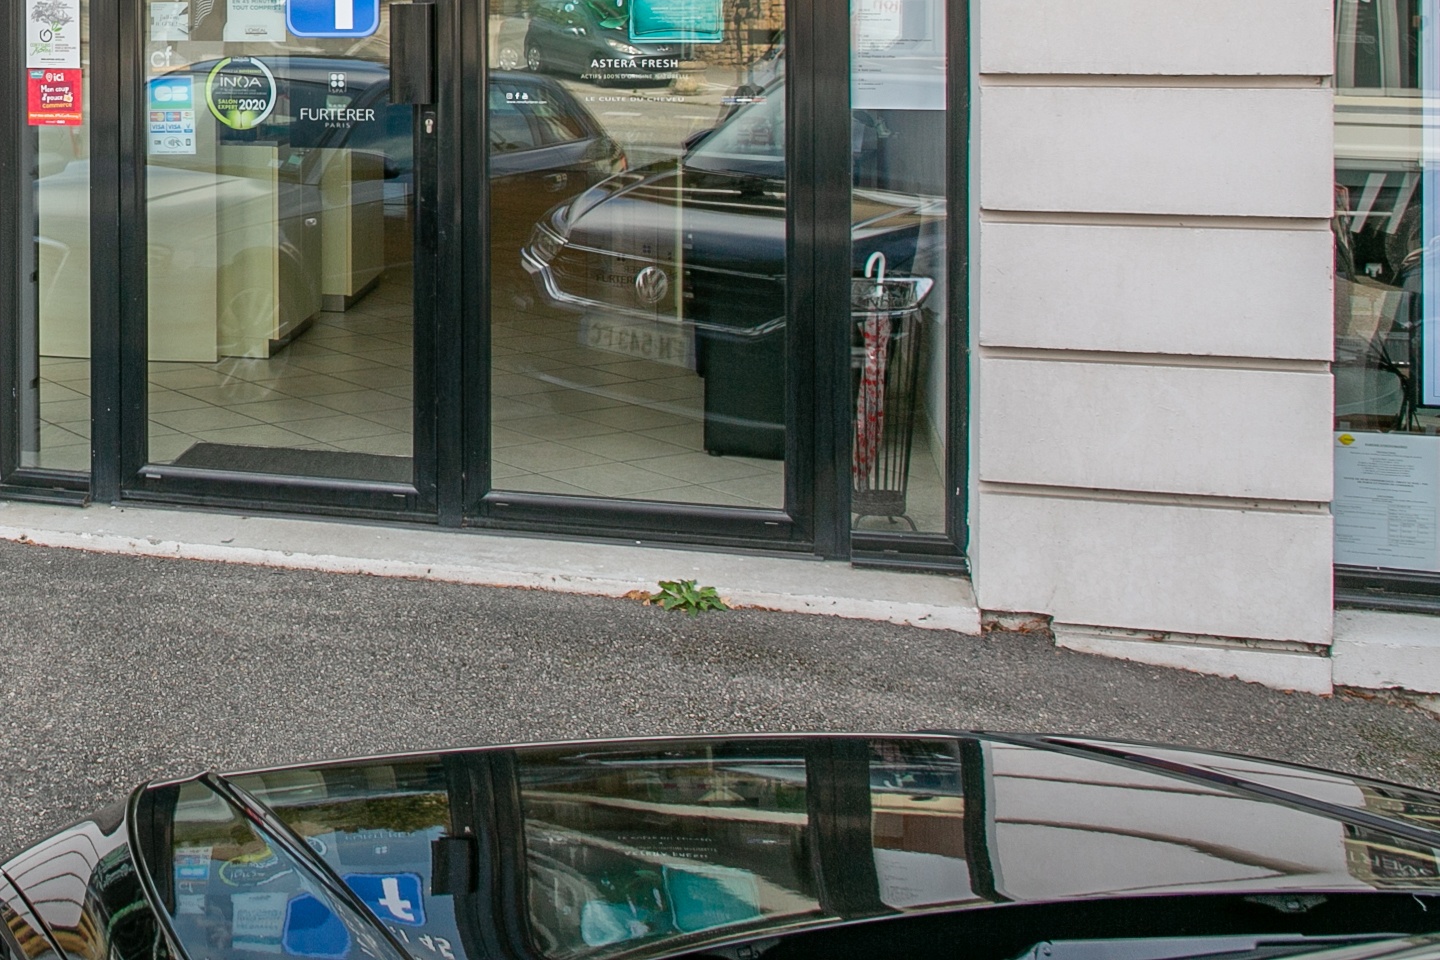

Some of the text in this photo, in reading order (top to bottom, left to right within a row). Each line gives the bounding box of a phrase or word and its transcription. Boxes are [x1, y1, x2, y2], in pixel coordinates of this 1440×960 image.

[591, 58, 679, 68] ASTERA FRESH
[40, 84, 70, 94] Mon coup
[238, 98, 266, 110] 2020
[300, 108, 376, 122] FURTERER
